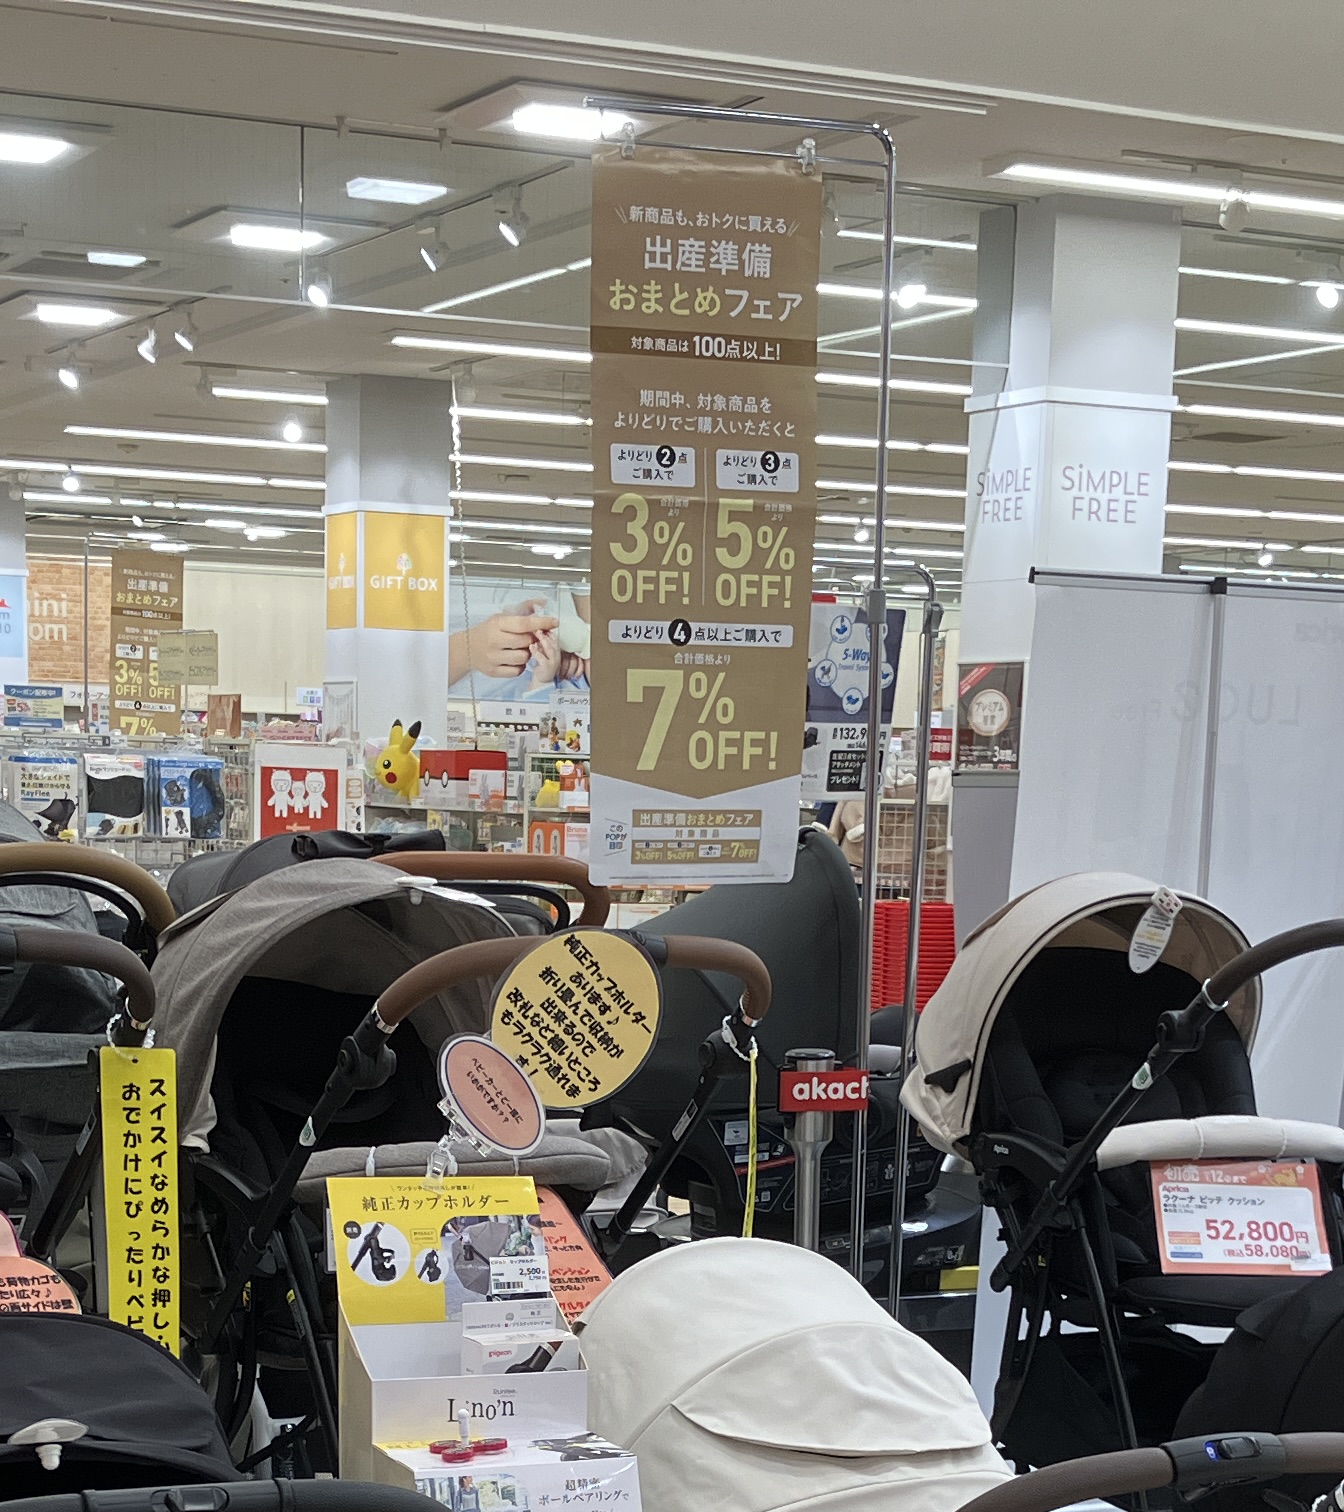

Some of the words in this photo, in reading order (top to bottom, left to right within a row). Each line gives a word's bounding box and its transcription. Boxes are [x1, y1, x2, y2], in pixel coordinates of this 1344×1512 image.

[629, 205, 787, 234] 新商品も、おトクに買える
[644, 235, 772, 278] 出産準備
[609, 279, 802, 322] おまとめフェア
[639, 389, 772, 414] 期間中、対象商品を
[614, 412, 796, 437] よりどりでご購入いただくと
[617, 445, 688, 468] よりどり2点
[723, 450, 792, 474] よりどり3点
[632, 468, 674, 481] ご購入で
[736, 474, 778, 486] ご購入で
[982, 497, 1023, 523] FREE
[1072, 497, 1137, 524] FREE
[609, 493, 693, 567] 3%
[715, 498, 795, 571] 5%
[370, 575, 404, 590] GIFT
[408, 577, 438, 591] BOX
[611, 569, 690, 606] OFF!
[715, 573, 792, 608] OFF!
[117, 593, 178, 607] おまとめフェア
[621, 619, 782, 646] よりどり4点以上ご購入で
[674, 652, 731, 665] 合計価格より
[626, 668, 735, 771] 7%
[688, 730, 778, 771] OFF!
[564, 934, 652, 1034] 純正カップホルダー
[538, 966, 624, 1059] 折り畳んで収納が
[507, 987, 602, 1093] 改札など細いところ
[540, 997, 597, 1058] 出来るので
[500, 1009, 582, 1099] もラクラク通れま
[472, 1057, 524, 1125] ベビーカーとご一緒に
[362, 1195, 509, 1212] 純正カップホルダー
[1162, 1195, 1196, 1204] ラクーナ
[1199, 1195, 1223, 1205] ビッテ
[1227, 1197, 1265, 1206] クッション
[1205, 1218, 1309, 1244] 52,800円
[488, 1350, 512, 1358] pigeon
[539, 1491, 629, 1506] ボールベアリングで
